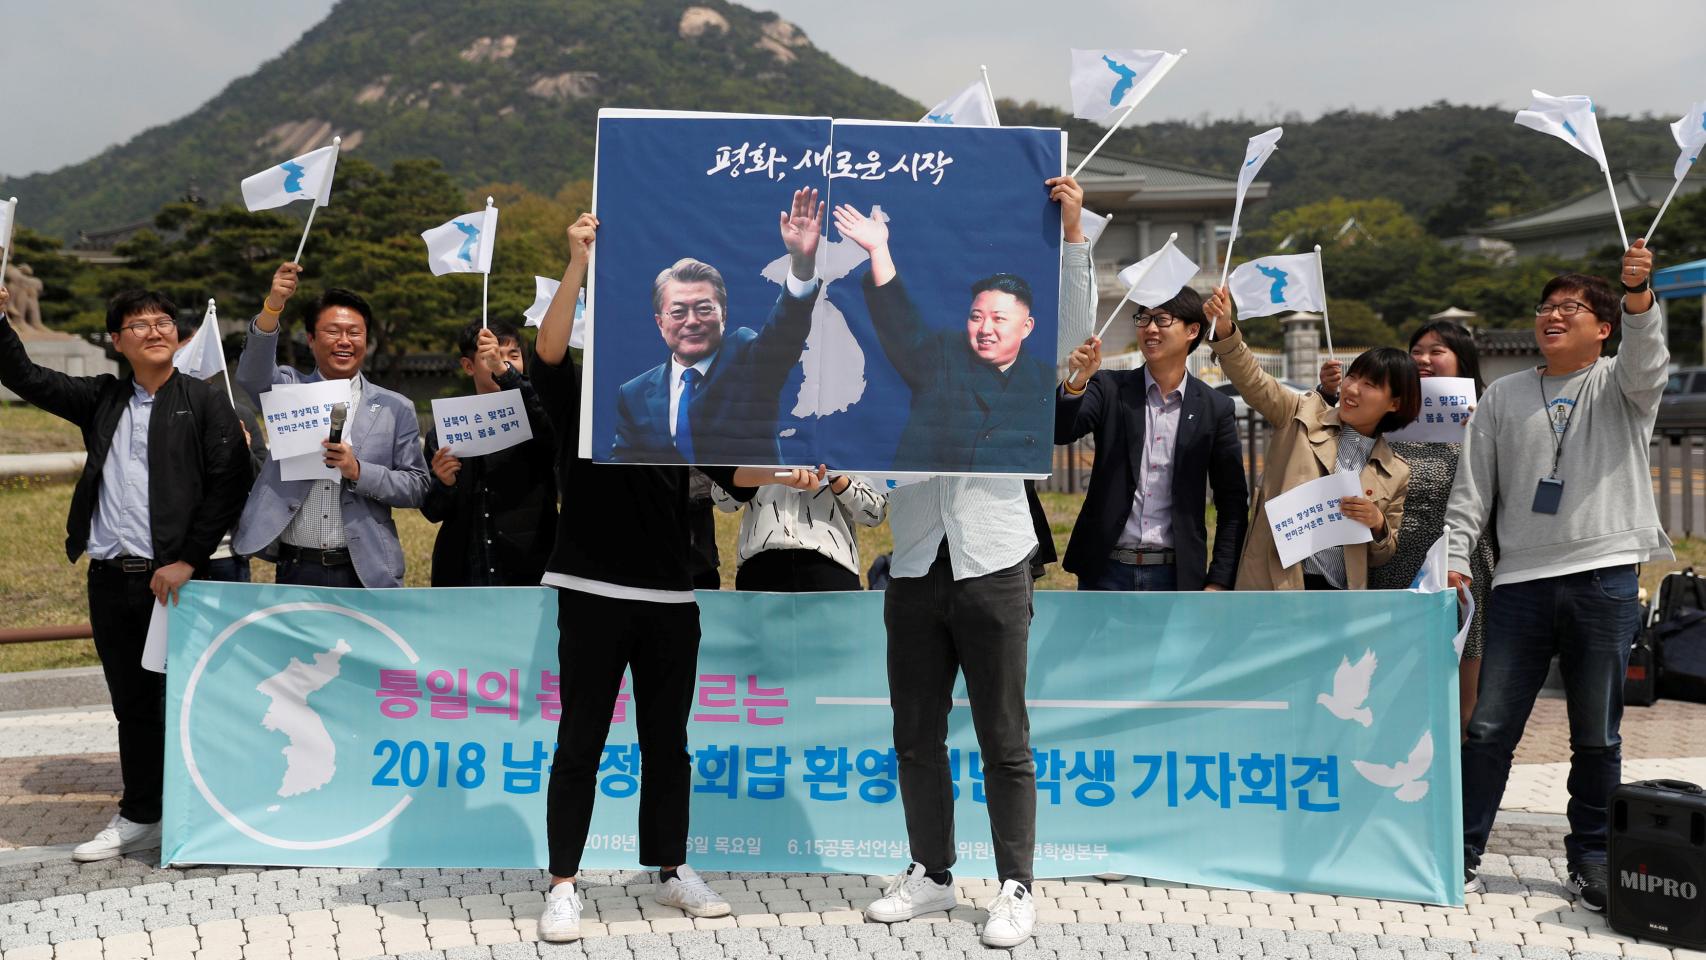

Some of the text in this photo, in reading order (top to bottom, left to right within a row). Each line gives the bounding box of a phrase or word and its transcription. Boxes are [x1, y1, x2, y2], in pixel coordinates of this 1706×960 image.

[706, 142, 953, 186] 평화, 새로운 시작
[1424, 395, 1467, 407] 손 맞잡고
[267, 412, 288, 423] 평화의
[291, 405, 320, 418] 정상회담
[443, 406, 515, 427] 남북이 손 맞잡고
[277, 419, 319, 435] 한미군사훈련
[446, 420, 519, 444] 평화의 봄을 열자
[1275, 516, 1294, 532] 평화의
[1296, 503, 1324, 521] 정상회담
[1285, 518, 1324, 541] 한미군사훈련
[376, 667, 519, 720] 통일의
[693, 673, 789, 726] 르는
[372, 739, 486, 789] 2018
[803, 746, 898, 804] 환영
[1131, 750, 1341, 812] 기자회견
[715, 837, 761, 856] 목요일
[787, 839, 912, 859] 6.15공동선언실
